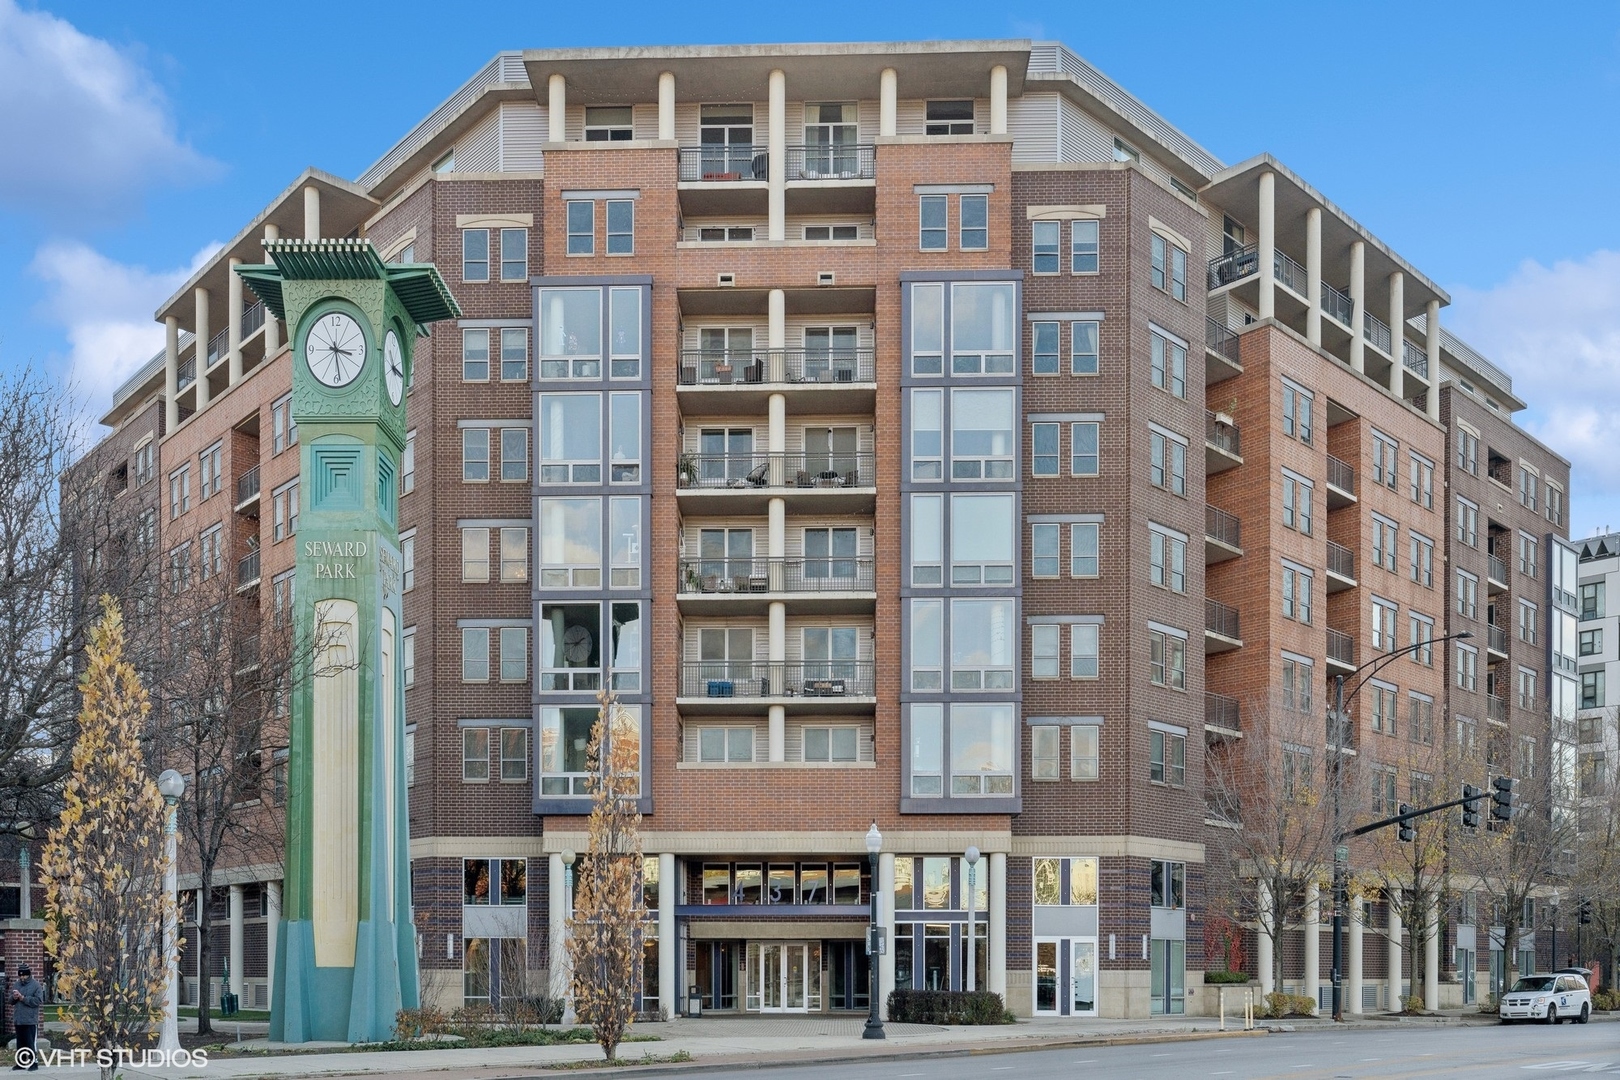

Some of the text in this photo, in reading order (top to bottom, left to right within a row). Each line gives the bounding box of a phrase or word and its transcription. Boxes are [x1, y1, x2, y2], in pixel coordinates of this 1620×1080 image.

[331, 316, 341, 327] 12
[308, 345, 364, 355] 9 3
[333, 374, 340, 384] 6
[304, 541, 367, 557] SEWARD
[316, 563, 356, 579] PARK
